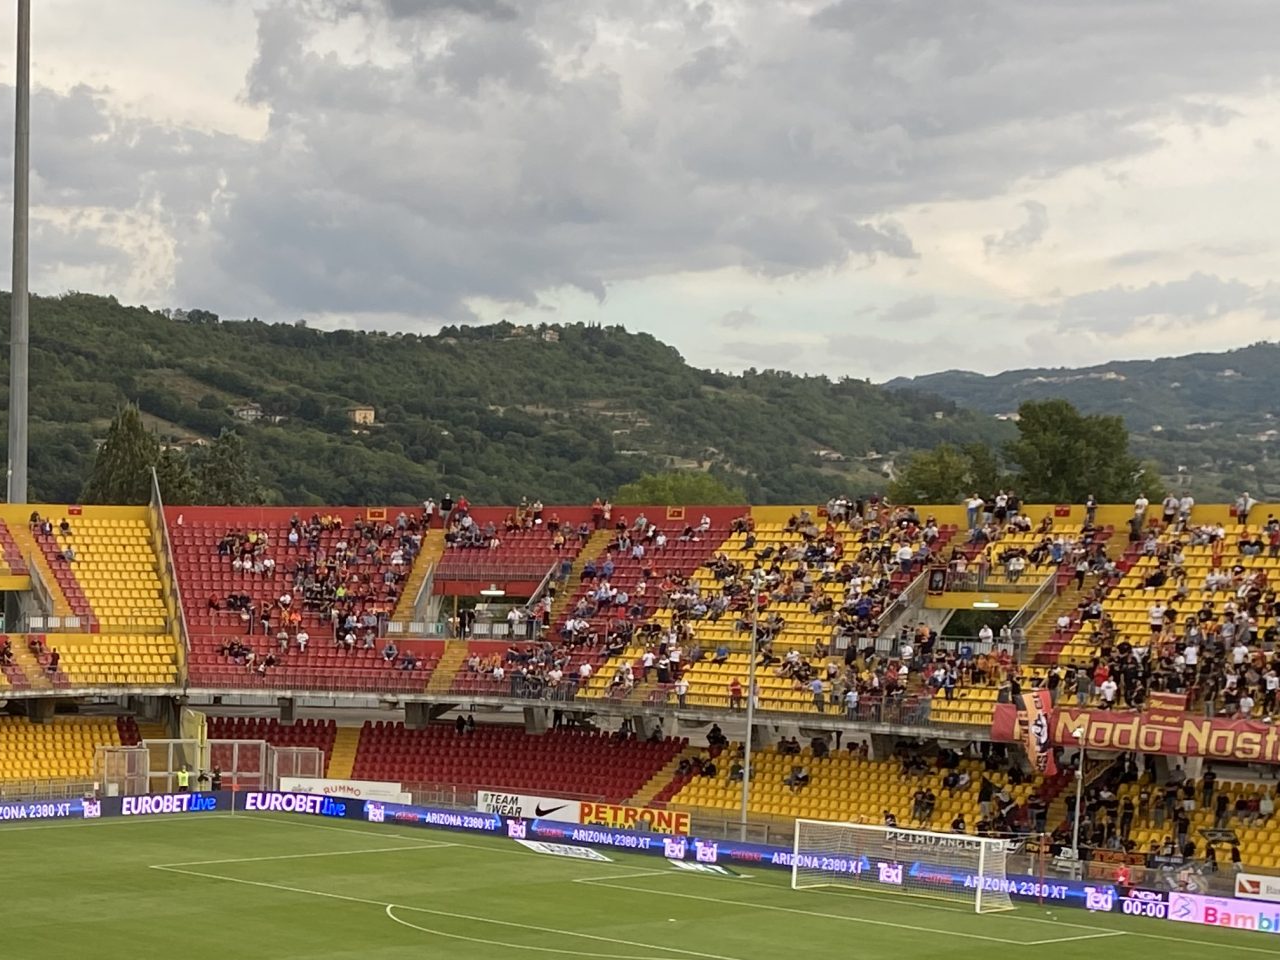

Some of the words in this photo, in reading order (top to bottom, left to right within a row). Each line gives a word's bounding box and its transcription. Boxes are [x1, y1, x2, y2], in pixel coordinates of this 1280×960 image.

[1179, 719, 1280, 760] Nost
[323, 785, 361, 797] RUMMO
[489, 793, 519, 805] TEAM
[57, 803, 71, 816] XT
[122, 794, 191, 815] EUROBET
[245, 792, 323, 814] EUROBET
[426, 812, 462, 827] ARIZONA
[483, 817, 496, 830] XT
[581, 803, 689, 835] PETRONE
[572, 829, 613, 845] ARIZONA
[637, 837, 651, 849] XT
[772, 851, 820, 868] ARIZONA
[1051, 885, 1069, 899] XT
[1084, 887, 1113, 912] Texi
[1123, 900, 1165, 918] 00:00
